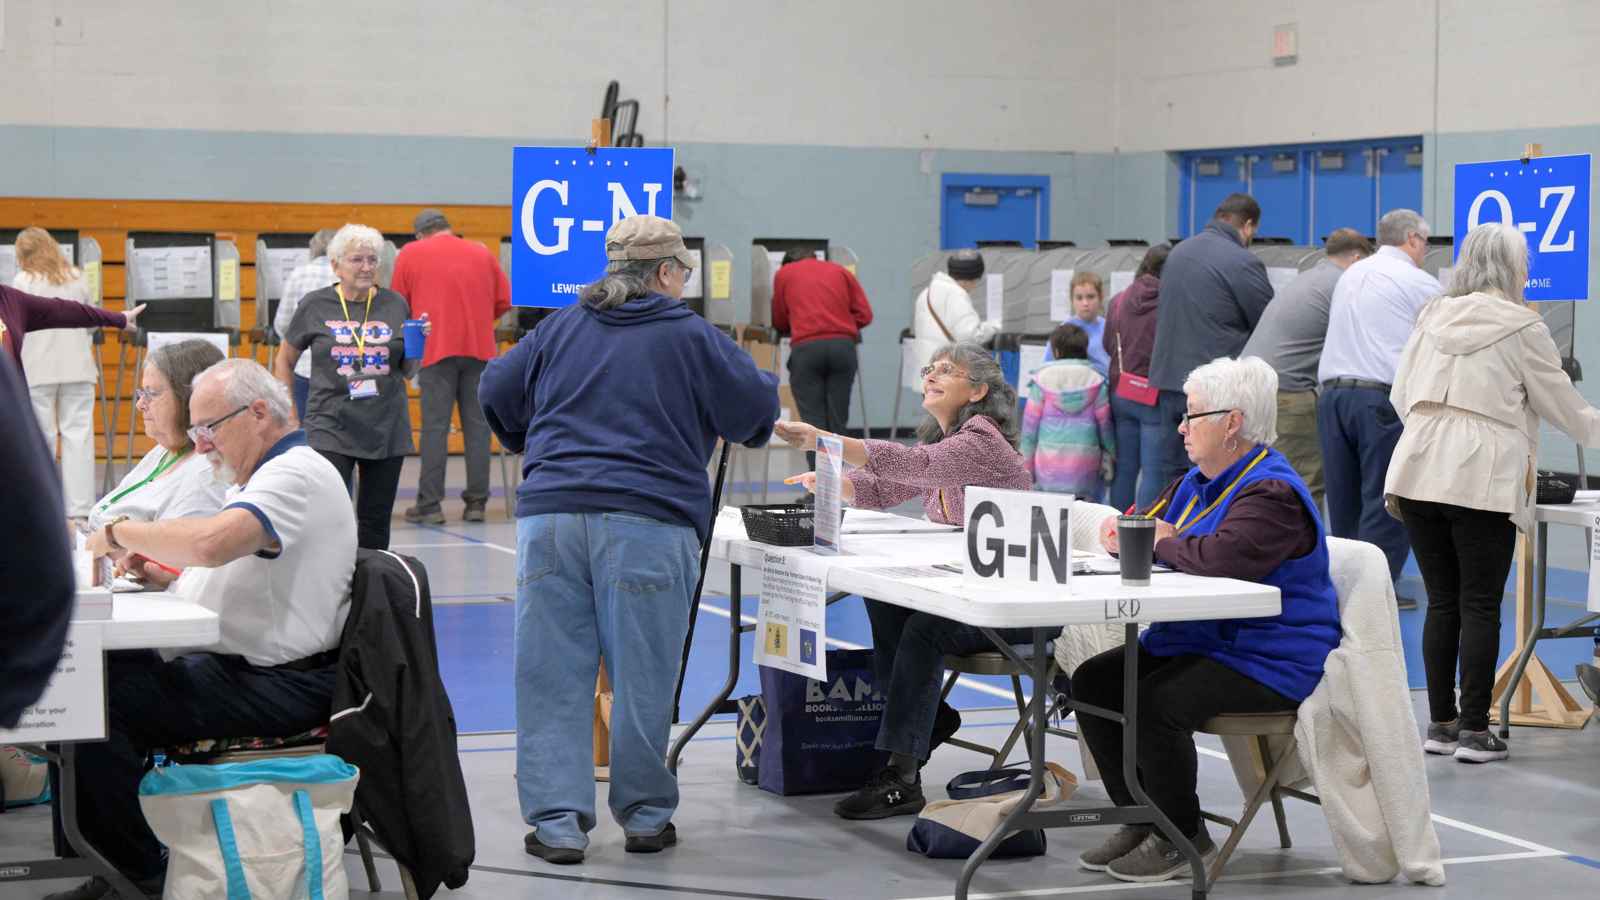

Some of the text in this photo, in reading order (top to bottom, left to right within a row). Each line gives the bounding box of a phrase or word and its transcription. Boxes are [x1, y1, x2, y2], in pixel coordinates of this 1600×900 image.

[521, 179, 662, 256] G-N
[1467, 186, 1576, 253] O-Z
[967, 500, 1069, 585] G-N
[1104, 598, 1141, 620] LRD
